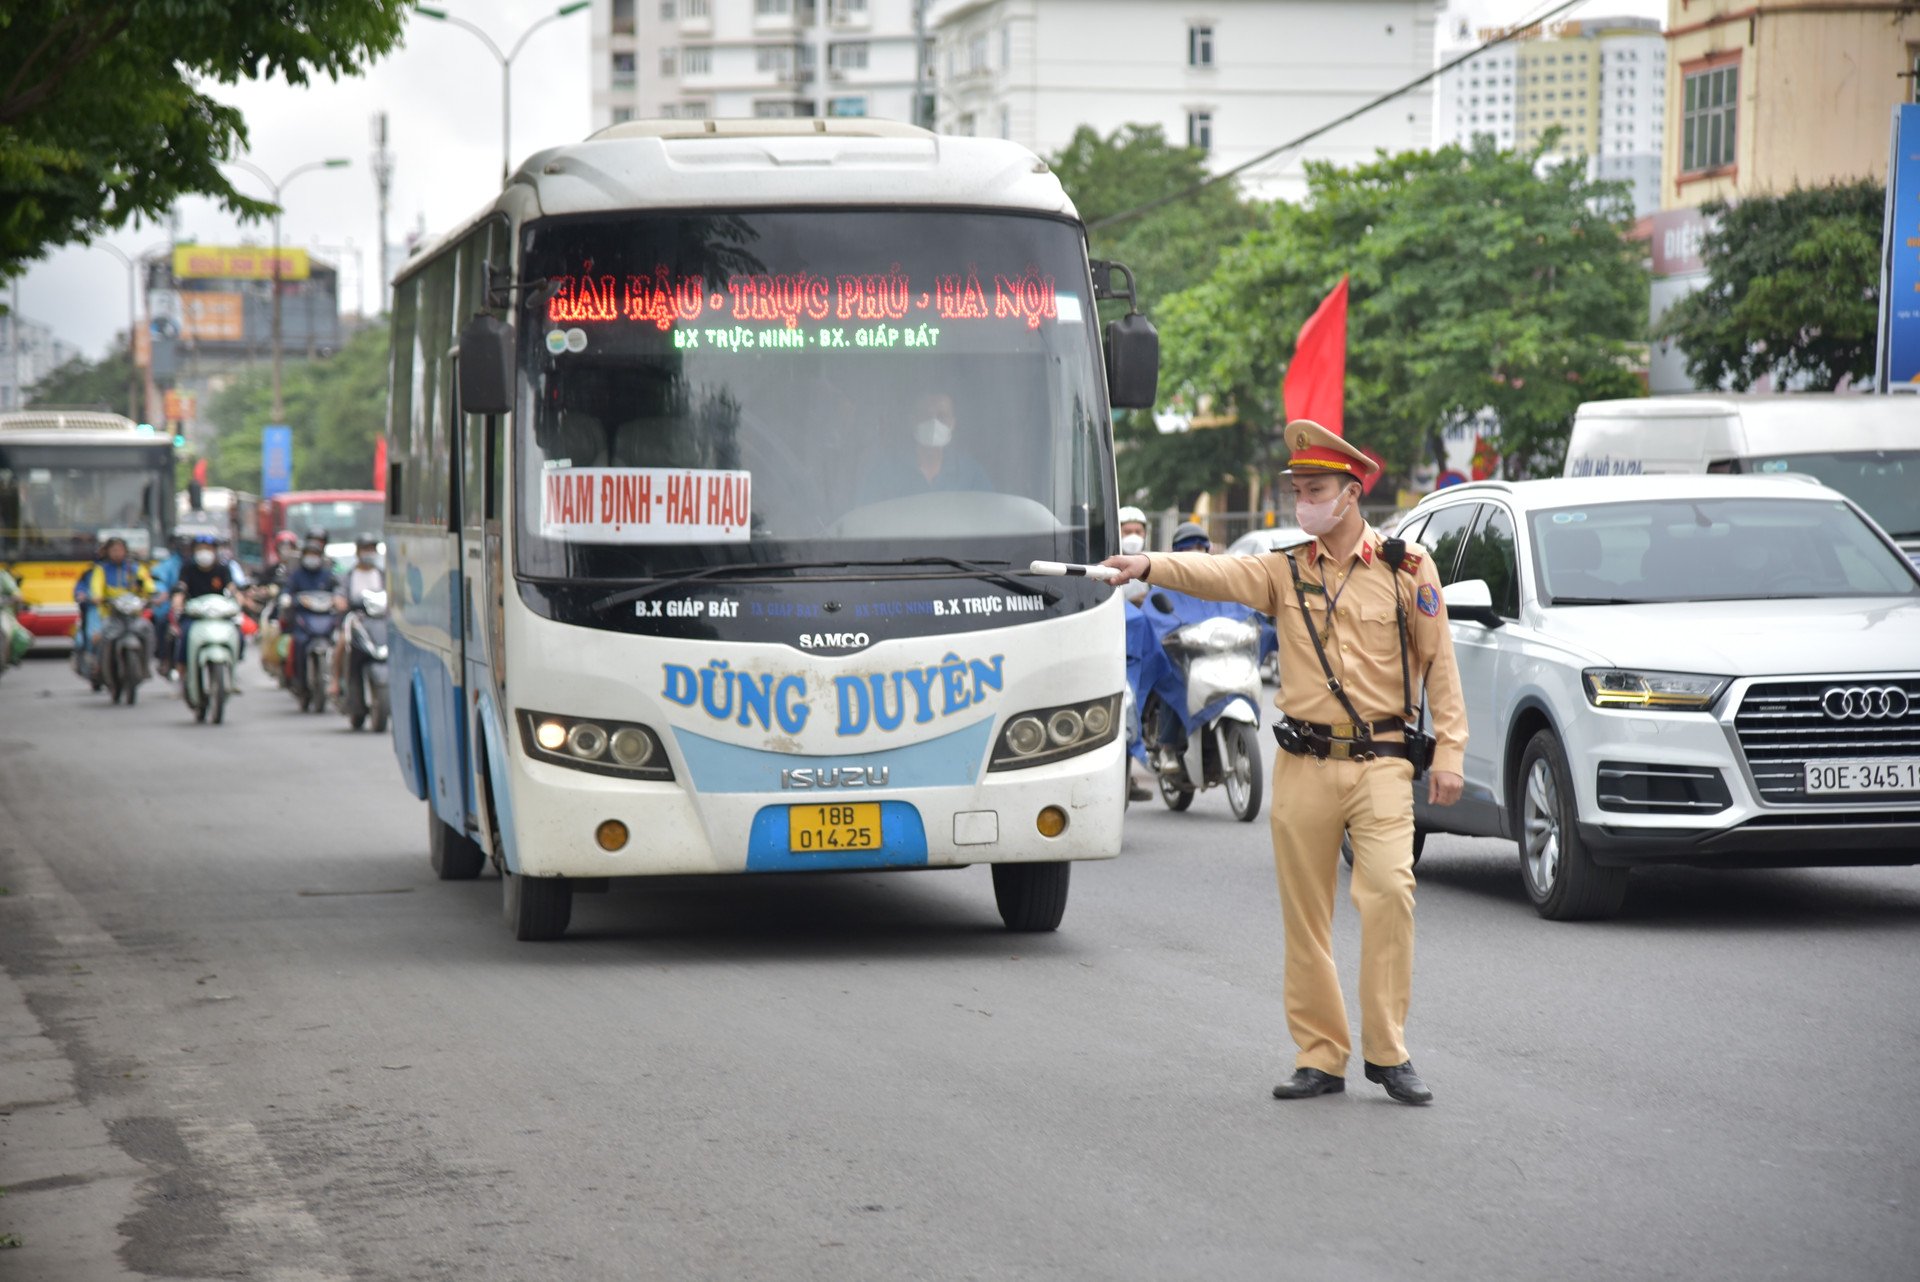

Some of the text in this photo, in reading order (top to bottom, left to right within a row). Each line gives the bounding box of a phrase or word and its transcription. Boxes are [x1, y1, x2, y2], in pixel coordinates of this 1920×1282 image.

[624, 265, 702, 330] HẬU
[728, 271, 829, 329] TRỰC
[994, 264, 1057, 328] NỘI
[705, 325, 754, 352] TRỰC
[759, 328, 804, 348] NINH
[855, 323, 899, 347] GIÁP
[546, 474, 594, 524] NAM
[600, 474, 650, 531] ĐỊNH
[666, 470, 701, 525] HẢI
[707, 472, 749, 533] HẬU
[635, 597, 740, 618] B.X GIÁP BÁT
[933, 594, 1045, 616] B.X TRỰC NINH
[799, 632, 870, 648] SAMCO
[661, 651, 1006, 737] DŨNG DUYÊN
[781, 765, 890, 788] ISUZU
[1809, 764, 1920, 789] 30E-345.1
[818, 807, 855, 825] 18B
[800, 828, 872, 849] 014.25
